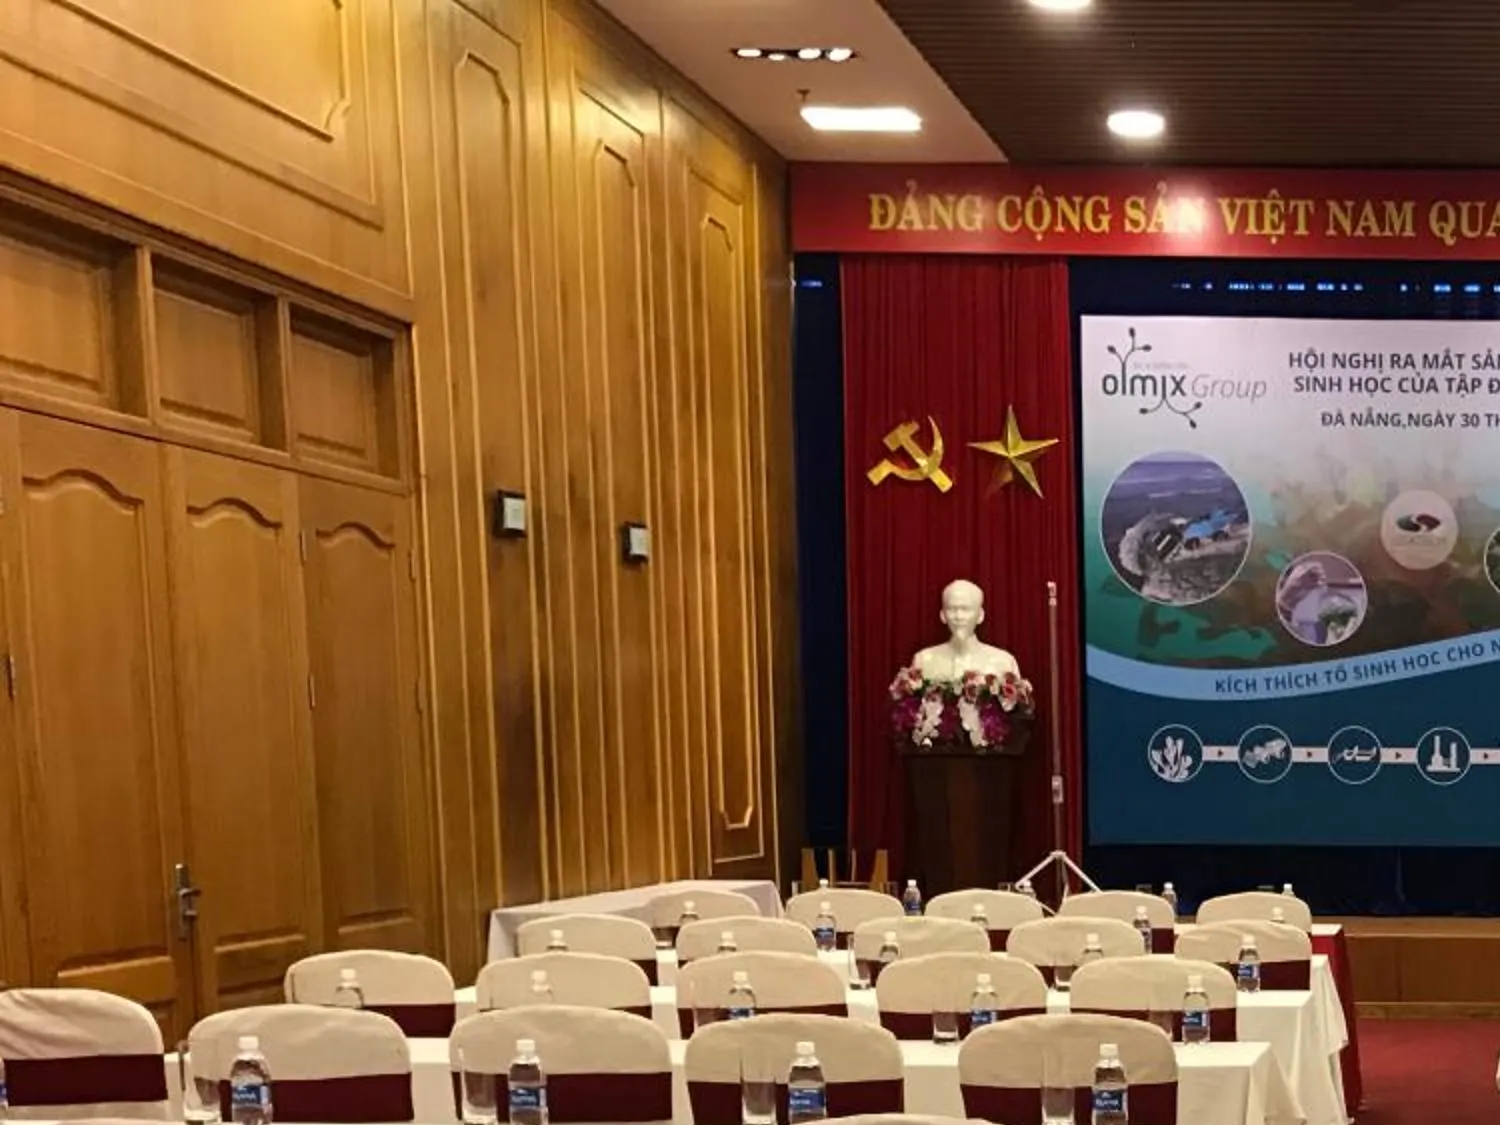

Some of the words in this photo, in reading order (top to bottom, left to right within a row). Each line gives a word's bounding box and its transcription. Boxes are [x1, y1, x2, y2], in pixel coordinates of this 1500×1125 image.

[868, 180, 986, 233] ĐẢNG
[998, 185, 1112, 241] CỘNG
[1218, 188, 1315, 245] VIỆT
[1326, 199, 1416, 238] NAM
[1289, 348, 1325, 373] HỘI
[1332, 353, 1384, 374] NGHỊ
[1390, 354, 1417, 370] RA
[1191, 373, 1268, 405] Group
[1293, 375, 1342, 393] SINH
[1349, 376, 1392, 398] HỌC
[1398, 372, 1438, 394] CỦA
[1445, 373, 1483, 398] TẬP
[1321, 408, 1344, 427] ĐÀ
[1461, 413, 1480, 428] 30
[1215, 674, 1257, 694] KÍCH
[1264, 671, 1318, 691] THÍCH
[1353, 658, 1397, 681] SINH
[1446, 643, 1484, 663] CHO
